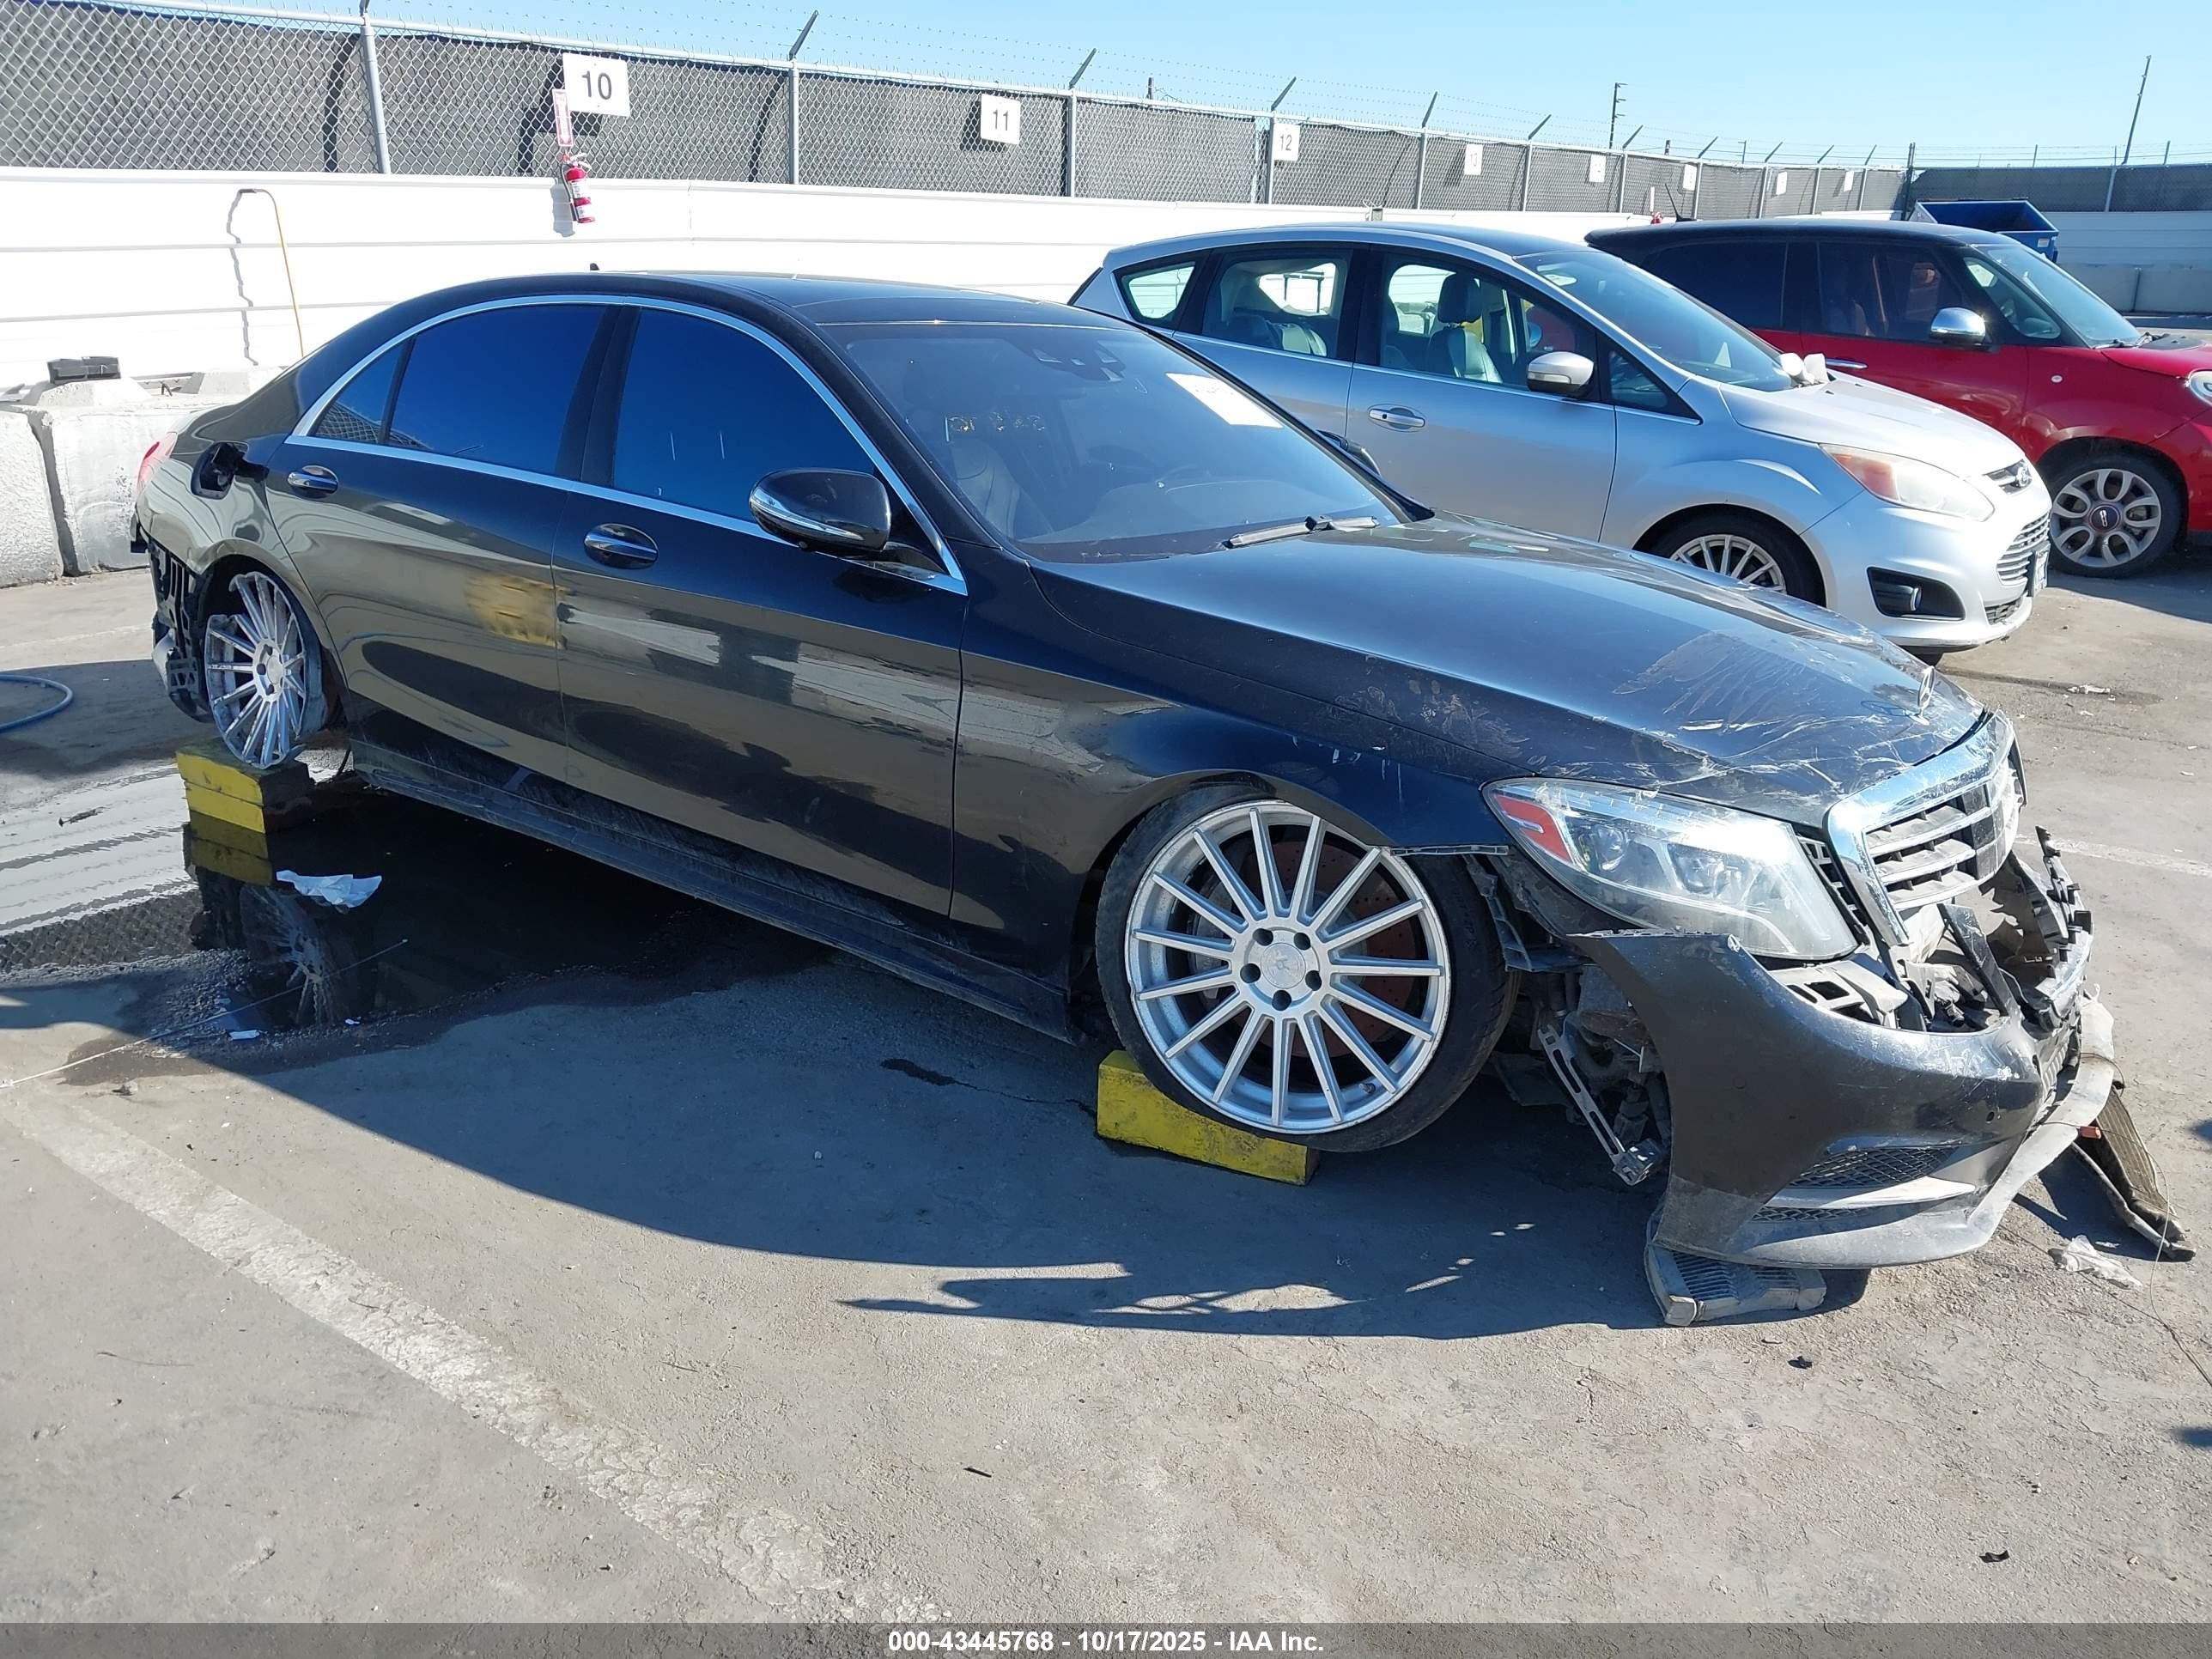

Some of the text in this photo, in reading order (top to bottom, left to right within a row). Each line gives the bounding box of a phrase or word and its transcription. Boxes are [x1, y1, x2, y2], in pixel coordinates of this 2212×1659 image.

[581, 70, 612, 100] 10
[992, 109, 1009, 131] 11
[1279, 134, 1292, 151] 12
